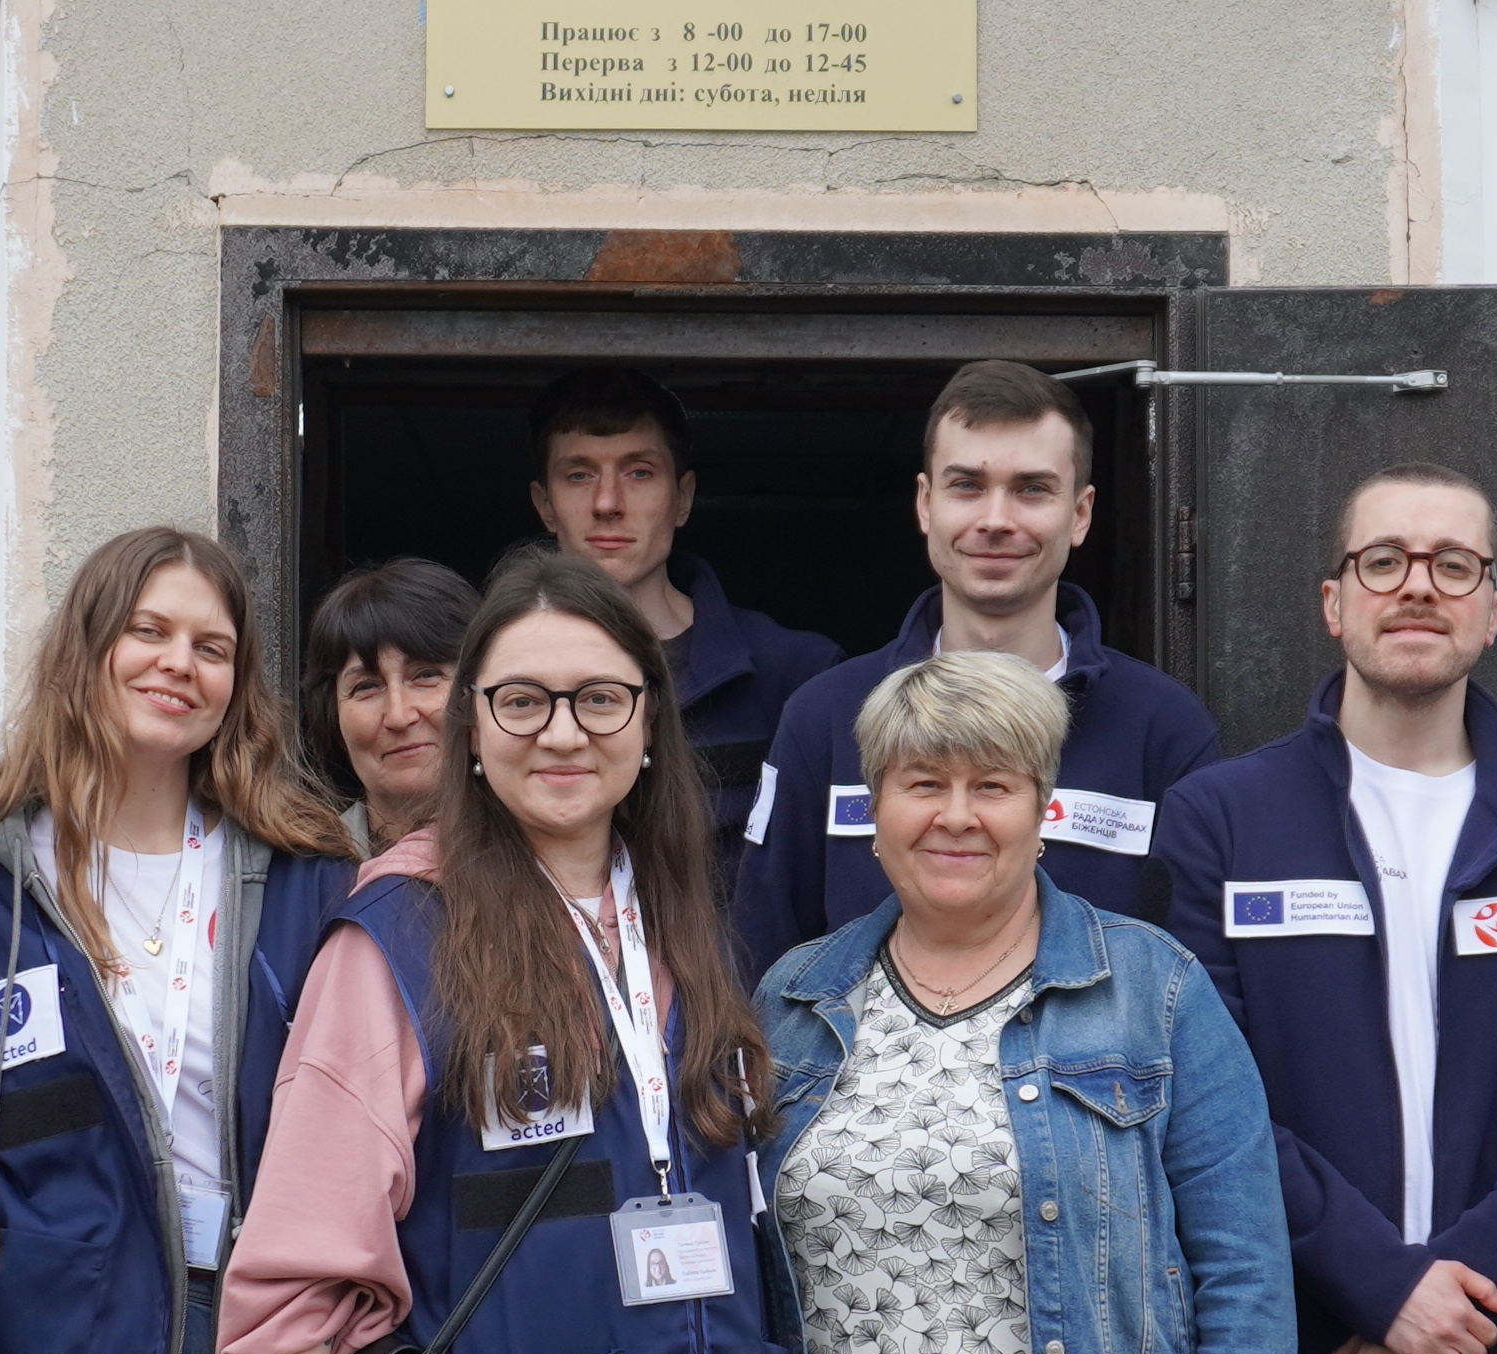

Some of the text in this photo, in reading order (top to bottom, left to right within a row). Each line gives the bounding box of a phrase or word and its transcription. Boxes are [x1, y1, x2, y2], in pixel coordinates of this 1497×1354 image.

[540, 21, 640, 46] Працює
[651, 27, 661, 42] з
[683, 22, 696, 42] 8
[764, 28, 792, 44] до
[805, 23, 867, 43] 17-00
[540, 52, 867, 76] Перерва з 12-00 до 12-45
[540, 82, 867, 108] Вихідні дні: субота, неділя
[1073, 802, 1127, 820] ЕСТОНСЬКА
[1071, 822, 1117, 839] БІЖЕНЦІВ
[1072, 812, 1148, 833] РАДА У СПРАВАХ
[1290, 891, 1339, 901] Funded by
[1290, 902, 1364, 911] European Union
[1290, 912, 1369, 922] Humanitarian Aid
[511, 1116, 565, 1141] acted
